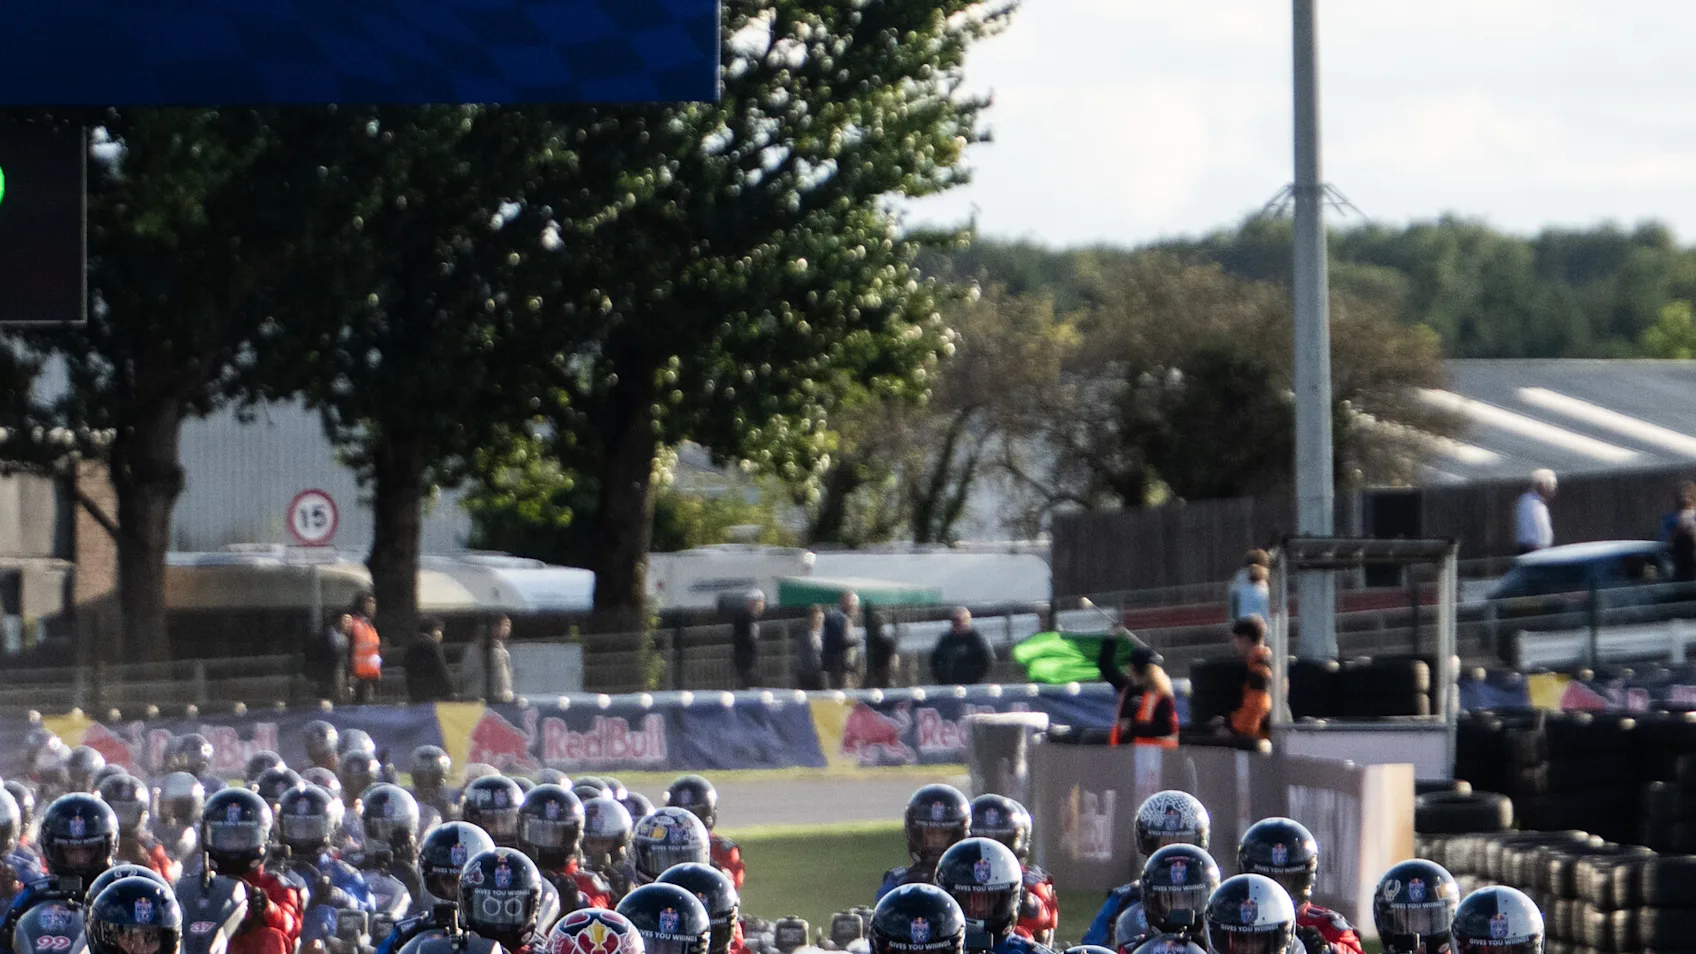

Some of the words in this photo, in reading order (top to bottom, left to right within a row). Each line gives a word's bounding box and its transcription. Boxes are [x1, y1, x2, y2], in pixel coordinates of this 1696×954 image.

[299, 503, 327, 529] 15
[954, 883, 971, 891] GIVES
[1220, 923, 1237, 931] GIVES
[639, 929, 654, 937] IVES
[655, 931, 671, 940] YOU
[672, 934, 698, 942] WIIINGS
[36, 935, 71, 951] 99
[888, 940, 907, 949] GIVES
[908, 942, 924, 950] YOU
[925, 940, 951, 950] WIIINGS
[1488, 938, 1504, 946] YOU
